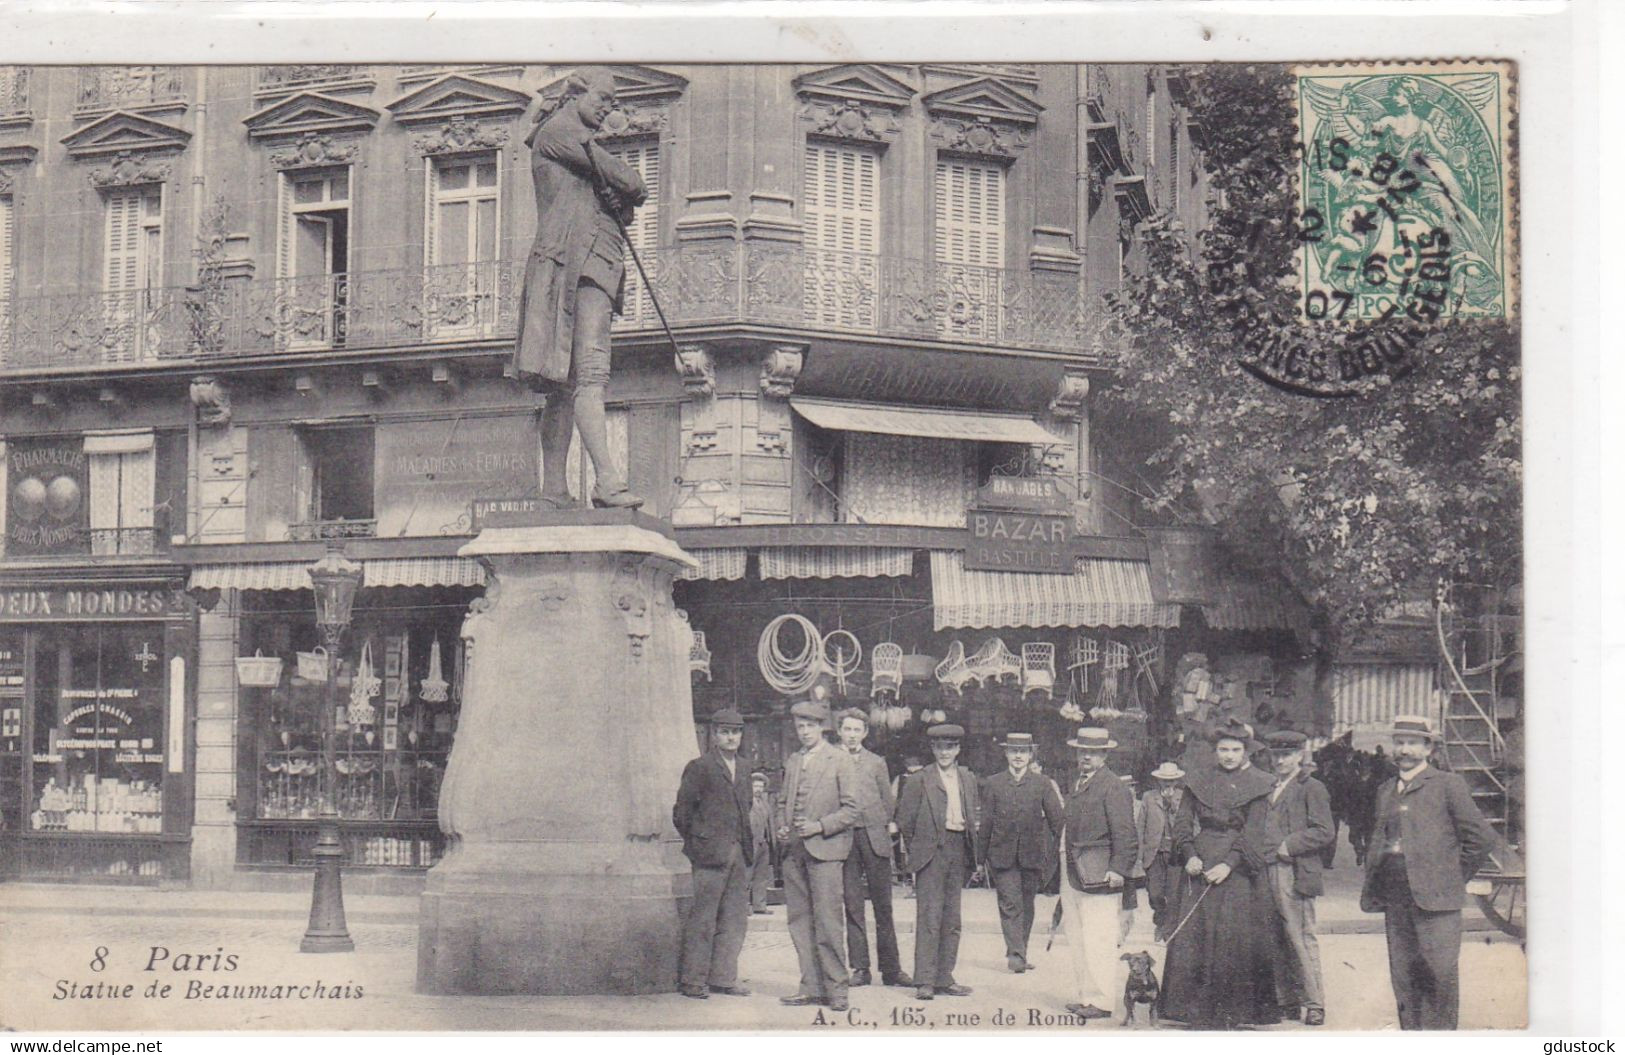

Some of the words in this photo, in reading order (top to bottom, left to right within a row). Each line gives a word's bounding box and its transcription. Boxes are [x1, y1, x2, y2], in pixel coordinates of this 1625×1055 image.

[1305, 289, 1355, 321] 07
[974, 513, 1065, 543] BAZAR
[66, 590, 164, 615] MONDES
